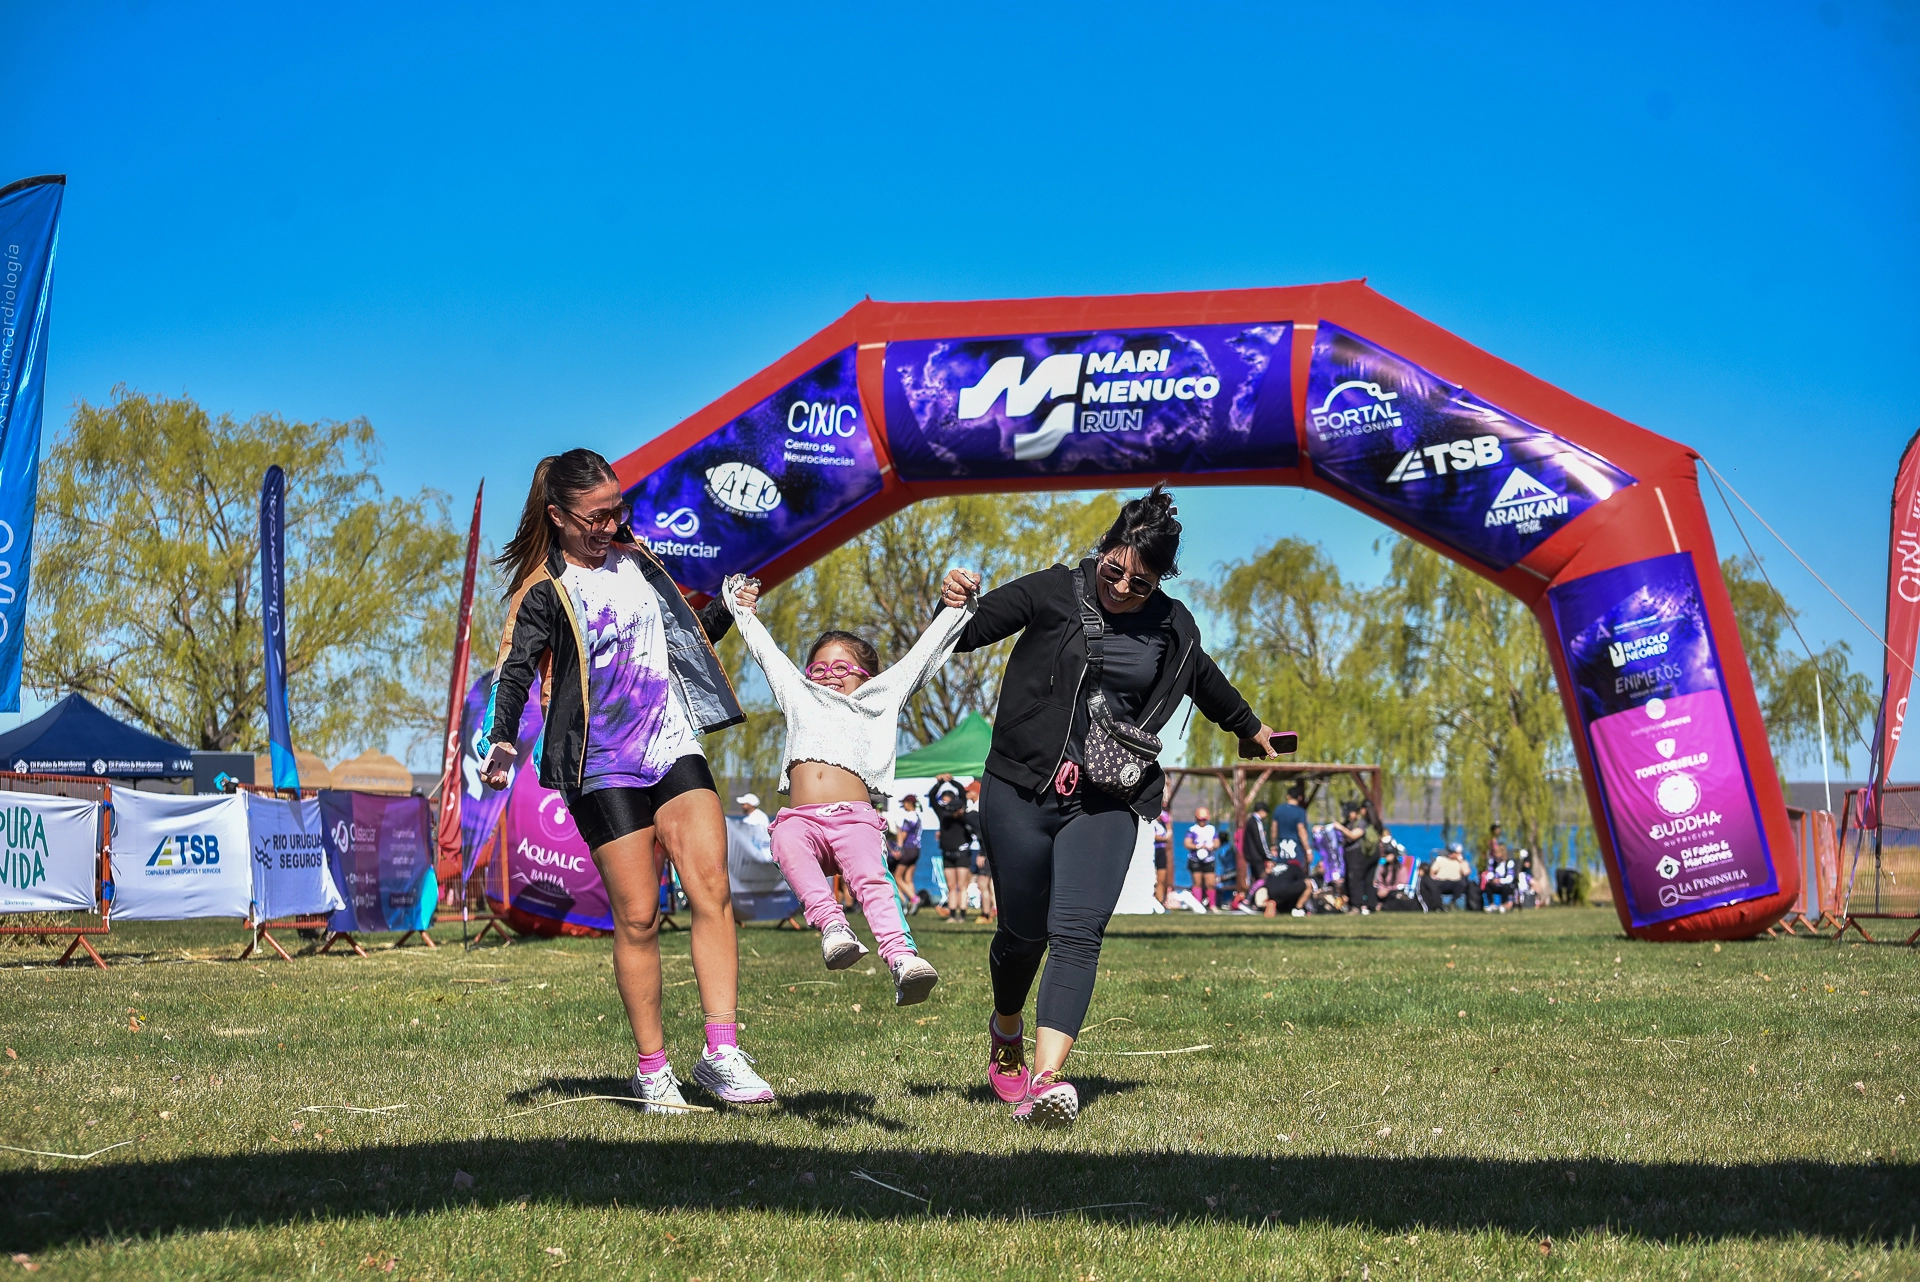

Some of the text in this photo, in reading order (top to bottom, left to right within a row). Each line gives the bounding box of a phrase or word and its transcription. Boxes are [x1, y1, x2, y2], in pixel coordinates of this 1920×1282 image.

[1085, 349, 1171, 375] MARI
[1082, 376, 1220, 404] MENUCO
[1080, 408, 1143, 433] RUN
[1312, 402, 1401, 432] PORTAL
[1325, 419, 1394, 439] PATAGONIA
[784, 438, 836, 454] Centro de
[783, 451, 856, 467] Neurociencias
[1484, 496, 1568, 528] ARAIKANI
[1635, 752, 1708, 780] TORTORIELLO
[1649, 810, 1722, 841] BUDDHA
[273, 834, 287, 850] RIO
[1692, 842, 1720, 857] Fabio
[280, 853, 322, 869] SEGUROS
[517, 837, 587, 873] AQUALIC
[1683, 850, 1733, 869] Mardones
[1692, 869, 1748, 890] PENINSULA
